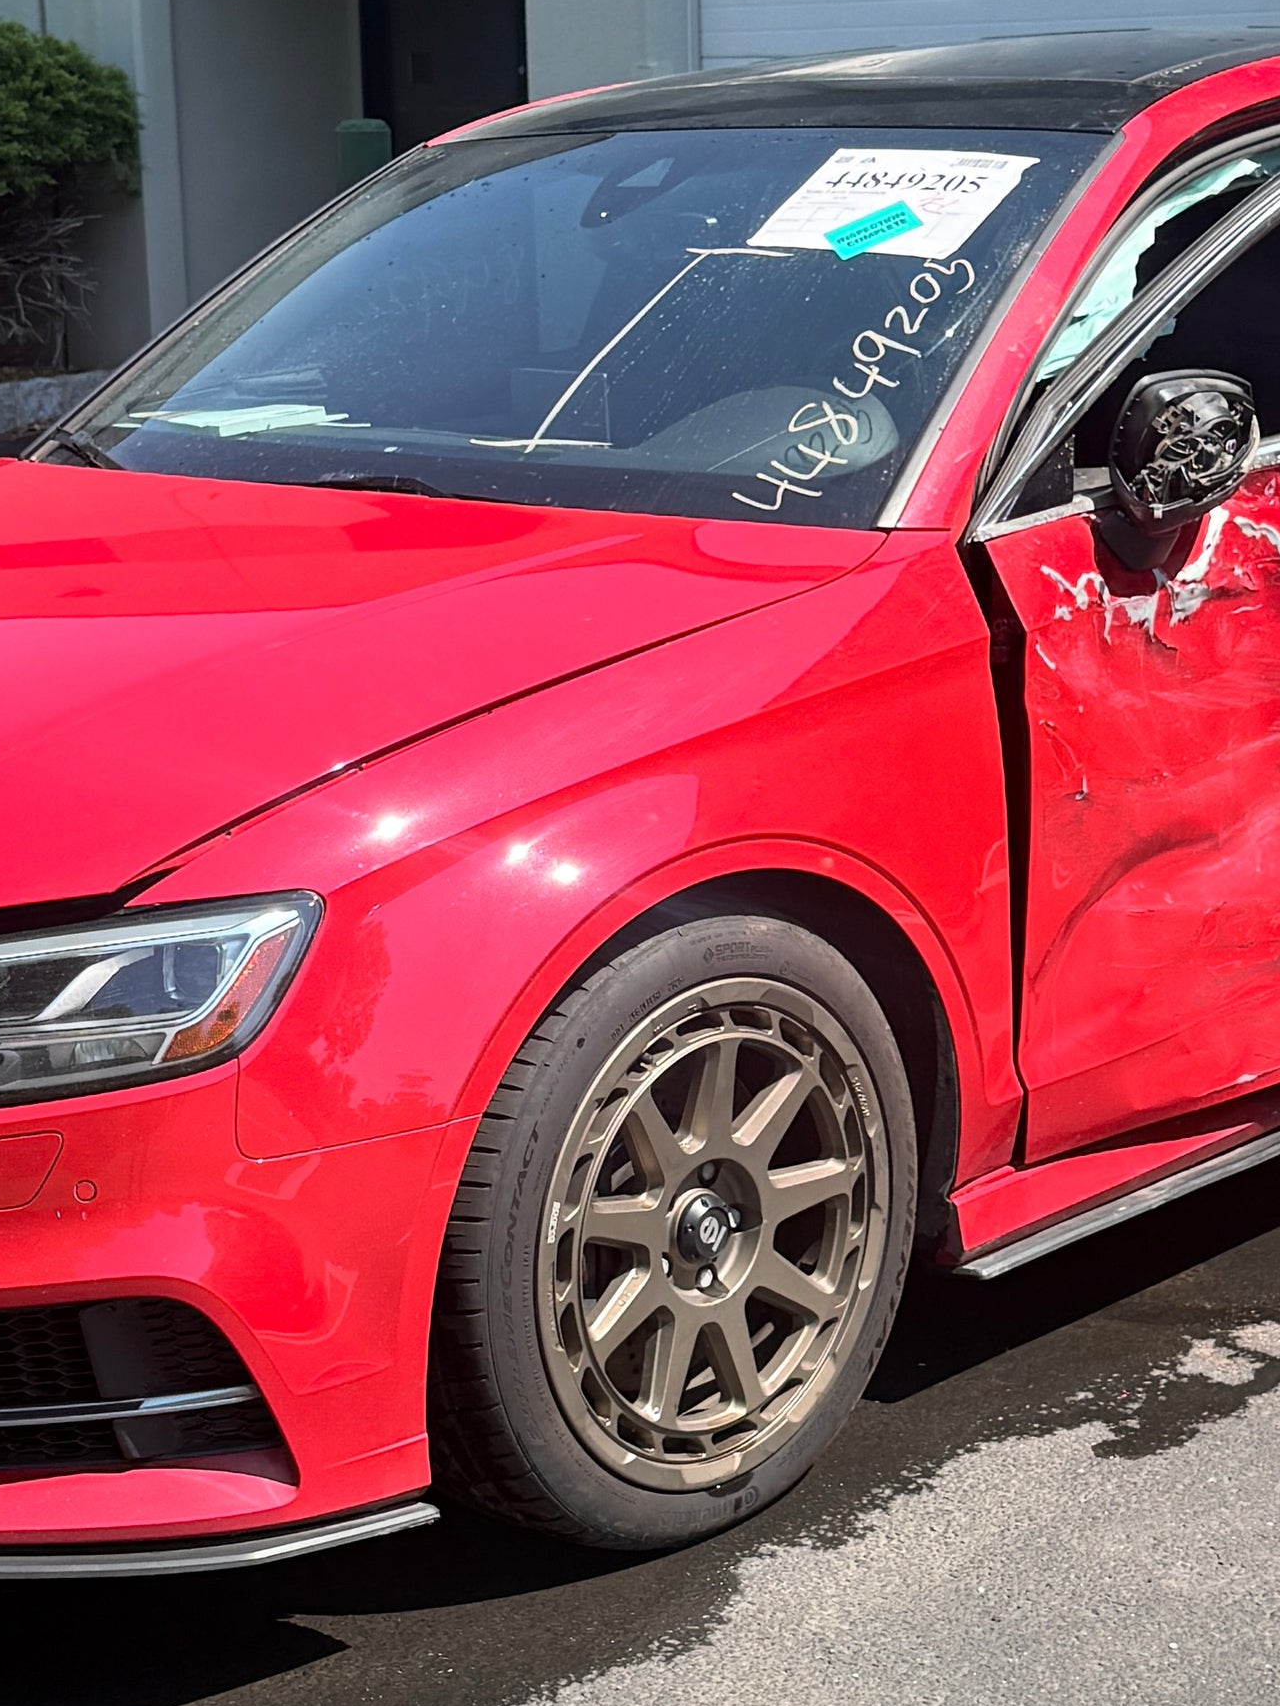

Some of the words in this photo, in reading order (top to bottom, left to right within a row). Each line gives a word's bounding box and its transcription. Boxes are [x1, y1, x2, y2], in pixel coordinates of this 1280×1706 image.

[825, 171, 989, 193] 44849205
[846, 218, 908, 247] COMPLETE
[732, 258, 975, 511] 44849205
